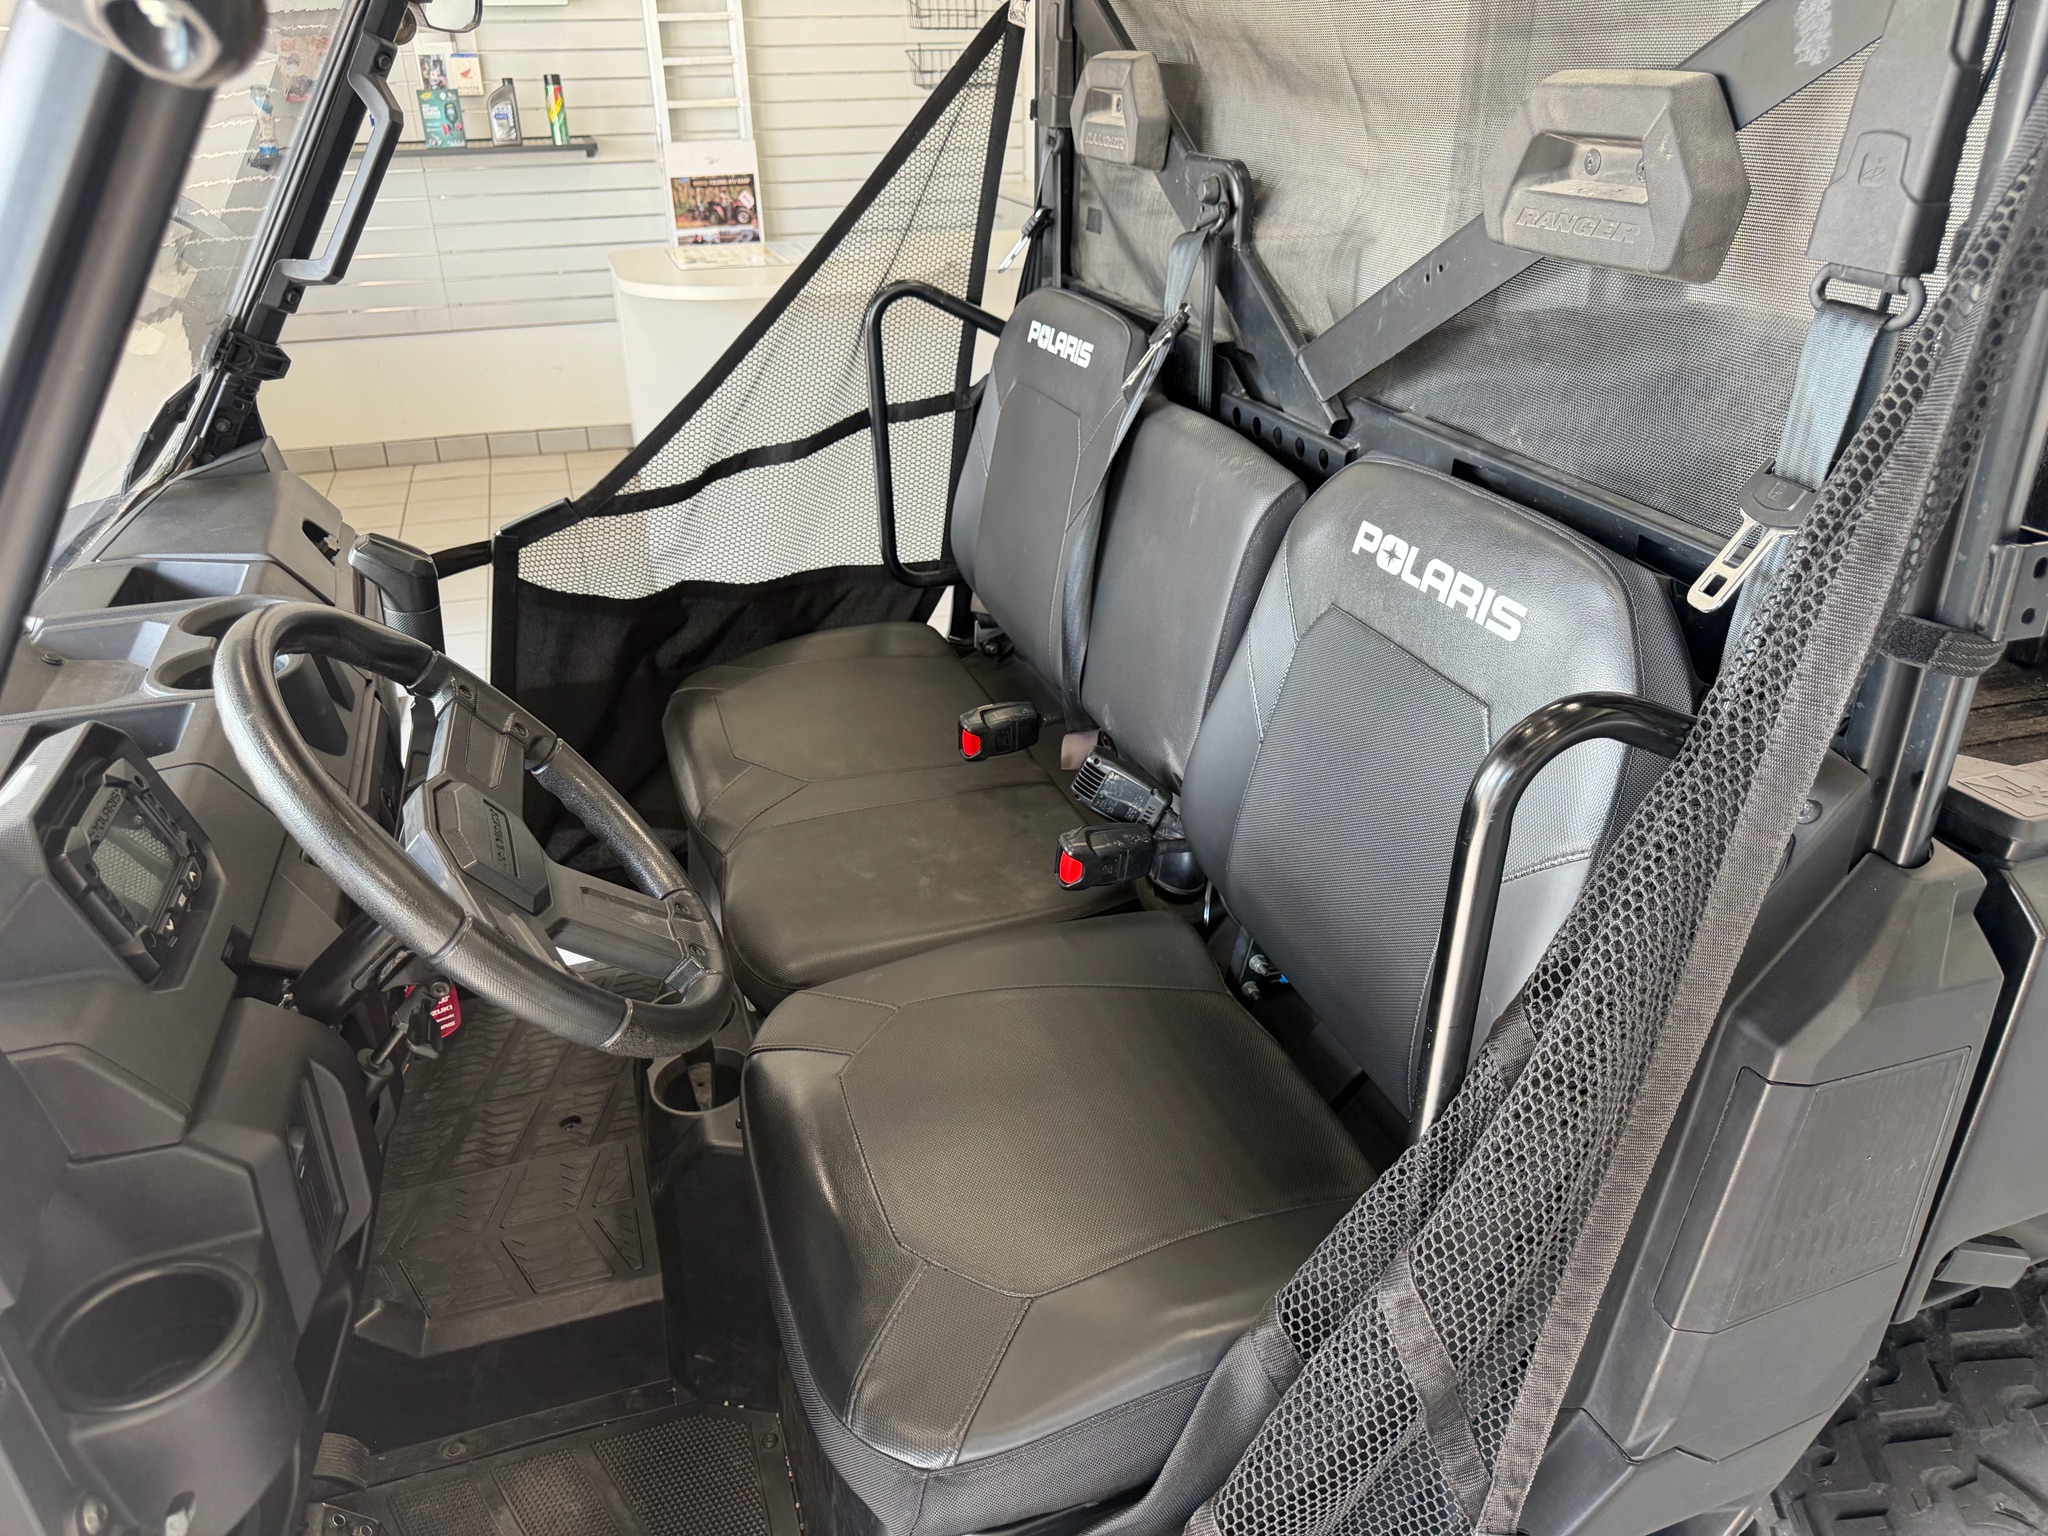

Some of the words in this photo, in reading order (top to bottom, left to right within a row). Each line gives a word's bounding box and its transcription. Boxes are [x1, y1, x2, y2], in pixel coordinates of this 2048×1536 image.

[1085, 132, 1126, 150] RANGER
[1515, 207, 1641, 244] RANGER
[1027, 320, 1095, 369] POLARIS
[1351, 520, 1528, 642] POLARIS
[430, 1004, 453, 1016] ZUKI
